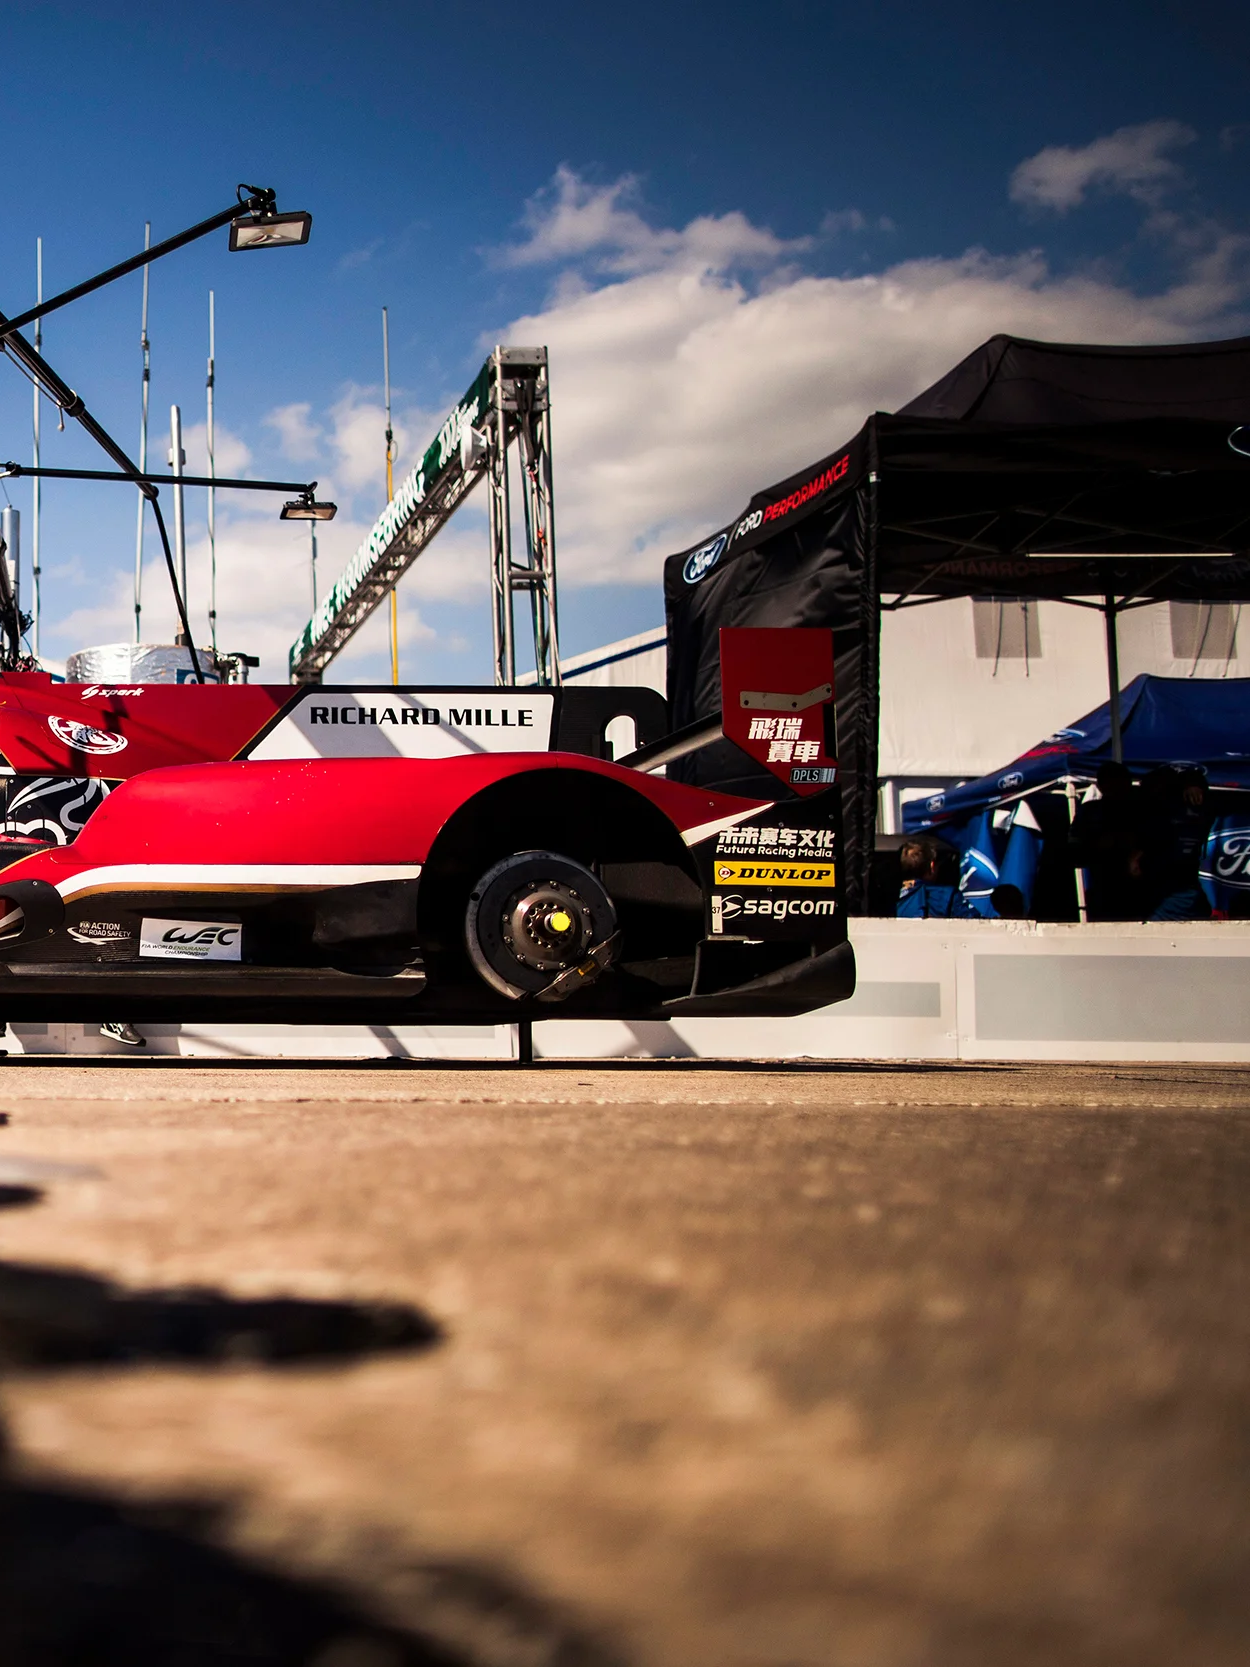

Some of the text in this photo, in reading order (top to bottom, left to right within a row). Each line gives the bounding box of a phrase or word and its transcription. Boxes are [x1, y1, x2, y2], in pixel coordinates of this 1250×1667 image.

[735, 454, 850, 540] FORD PERFORMANCE
[99, 687, 144, 697] spark
[310, 706, 534, 727] RICHARD MILLE
[766, 740, 821, 763] 賽車
[793, 769, 819, 781] DPLS
[716, 844, 833, 859] Future Racing Media
[737, 867, 831, 880] DUNLOP
[712, 906, 721, 914] 37
[743, 899, 835, 919] sagcom
[89, 929, 106, 937] ROAD
[91, 922, 120, 931] ACTION
[162, 926, 239, 946] WEC
